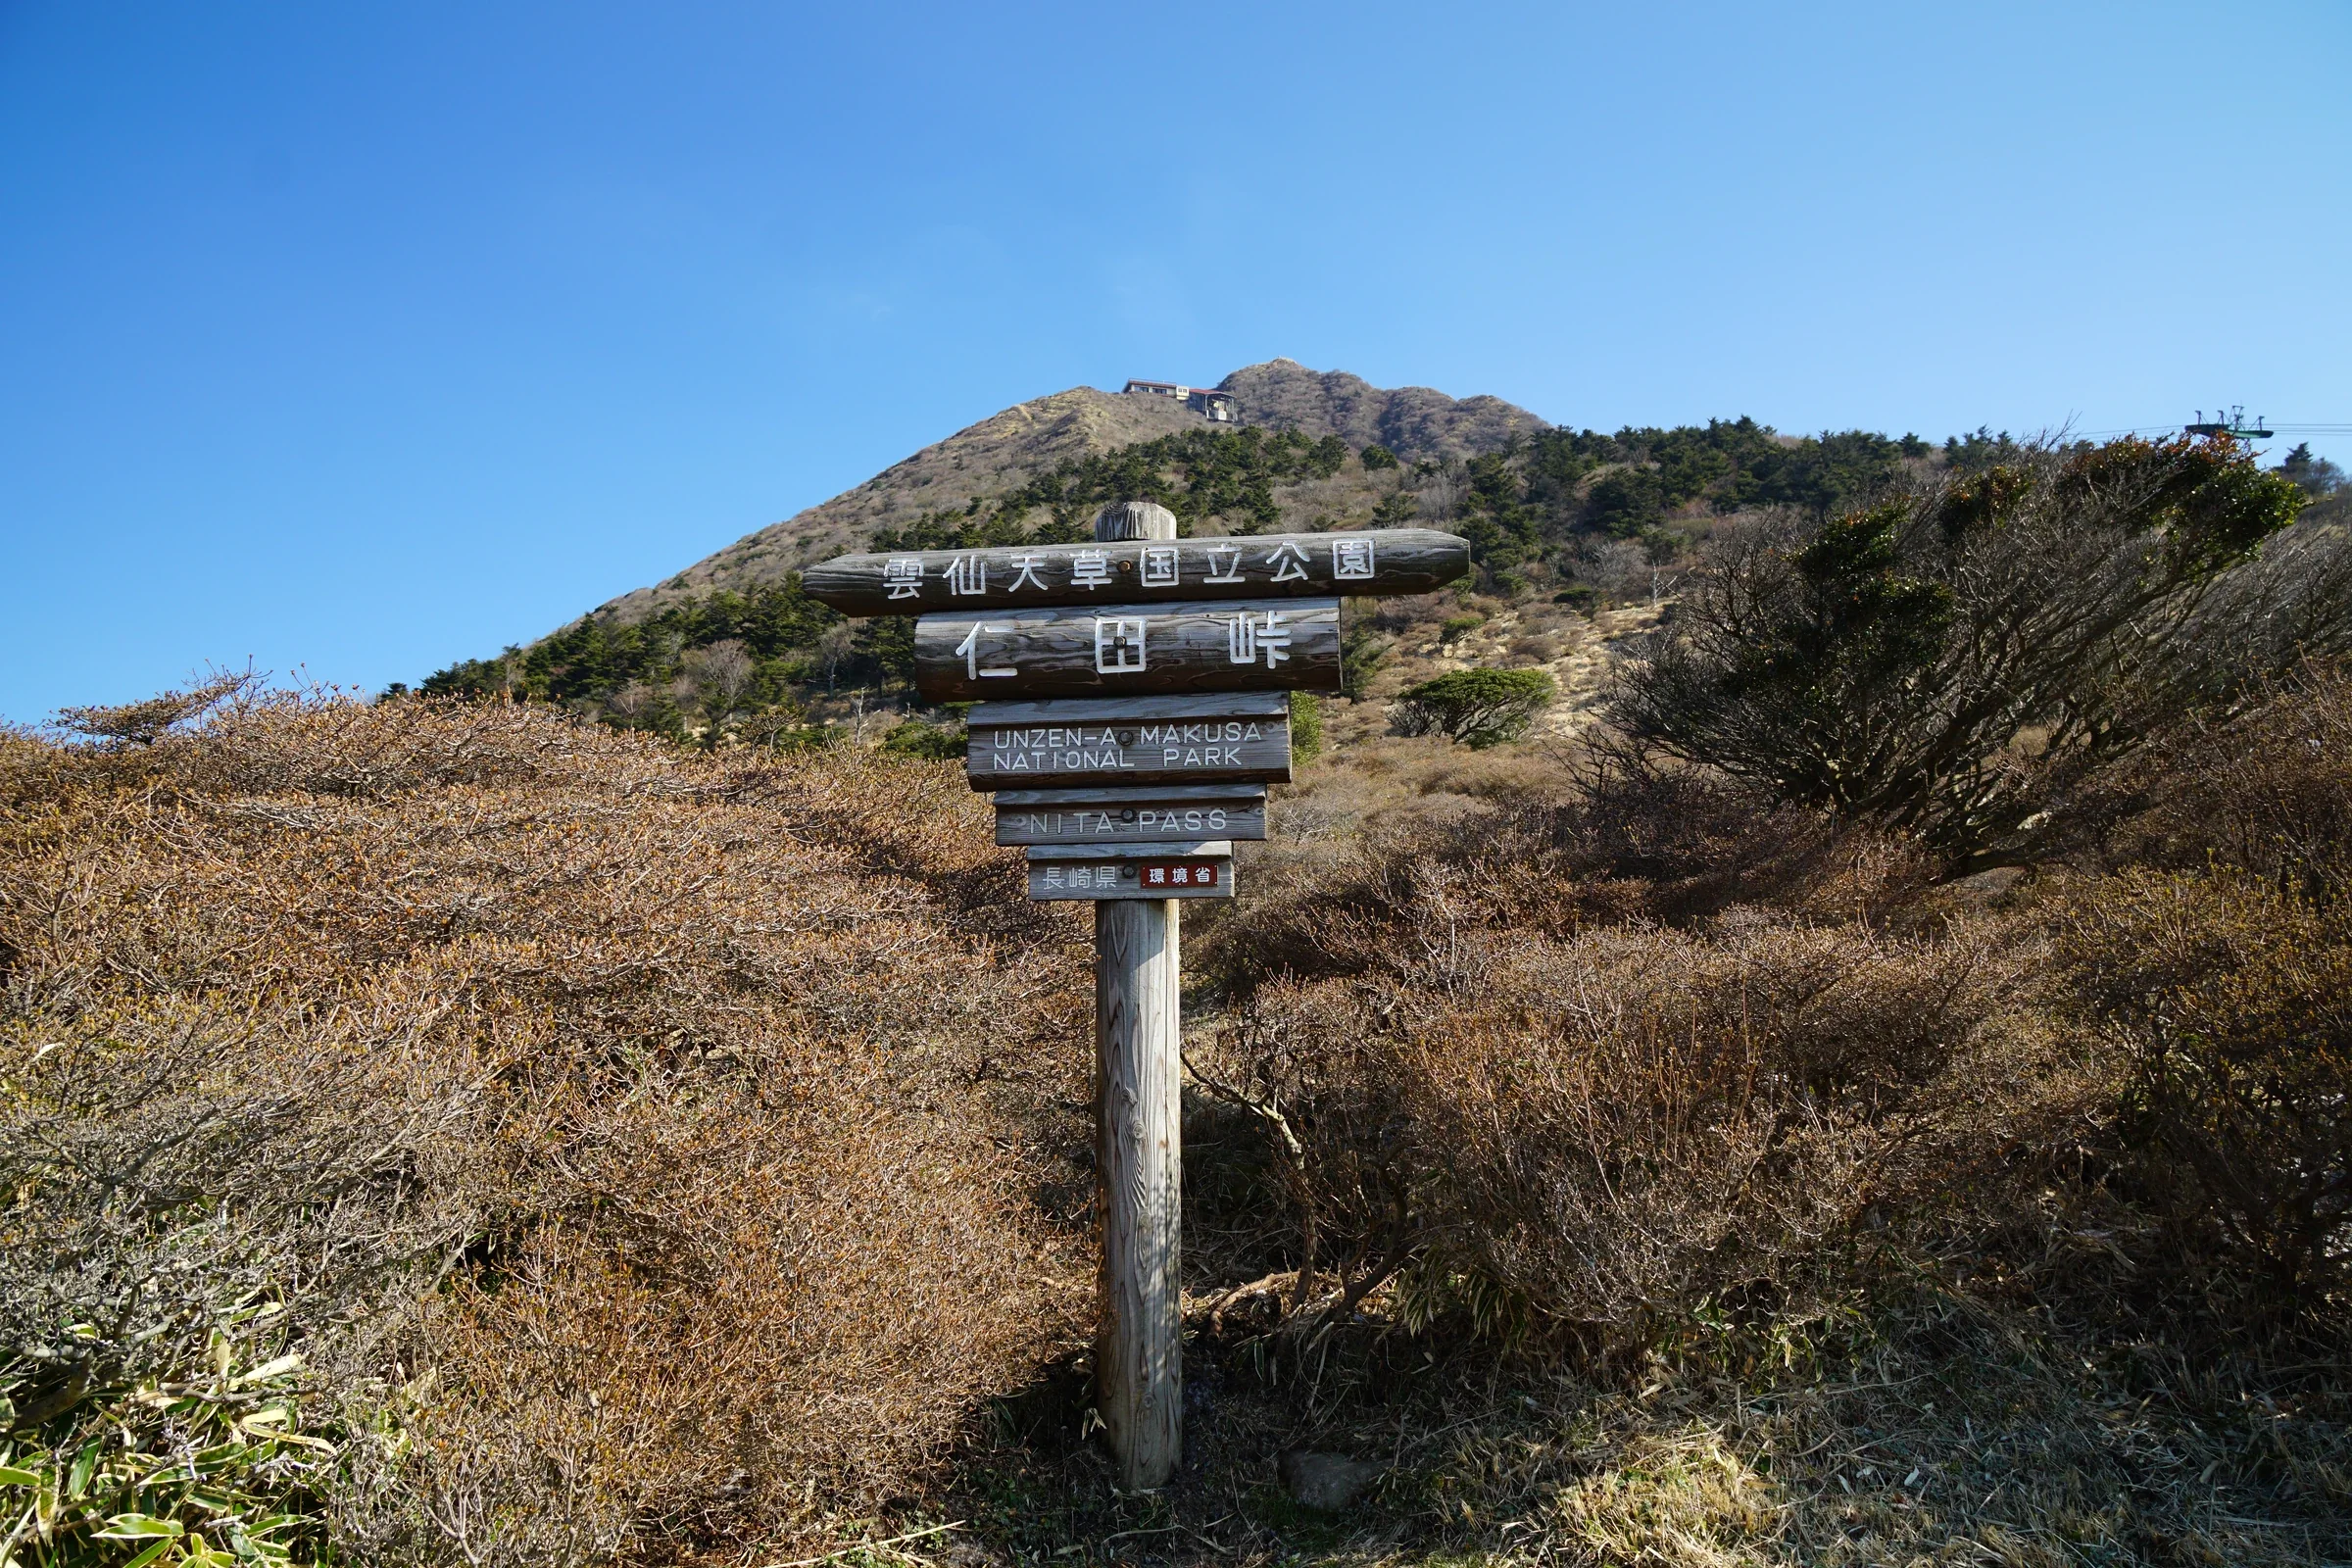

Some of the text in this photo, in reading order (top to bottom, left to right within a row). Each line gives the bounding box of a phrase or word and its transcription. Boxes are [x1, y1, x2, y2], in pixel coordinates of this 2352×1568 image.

[883, 538, 1375, 600] 雲仙天草国立公園
[956, 611, 1292, 680] 仁田峠
[994, 747, 1243, 771] NATIONAL PARK
[1042, 865, 1211, 890] 長崎県 環境省
